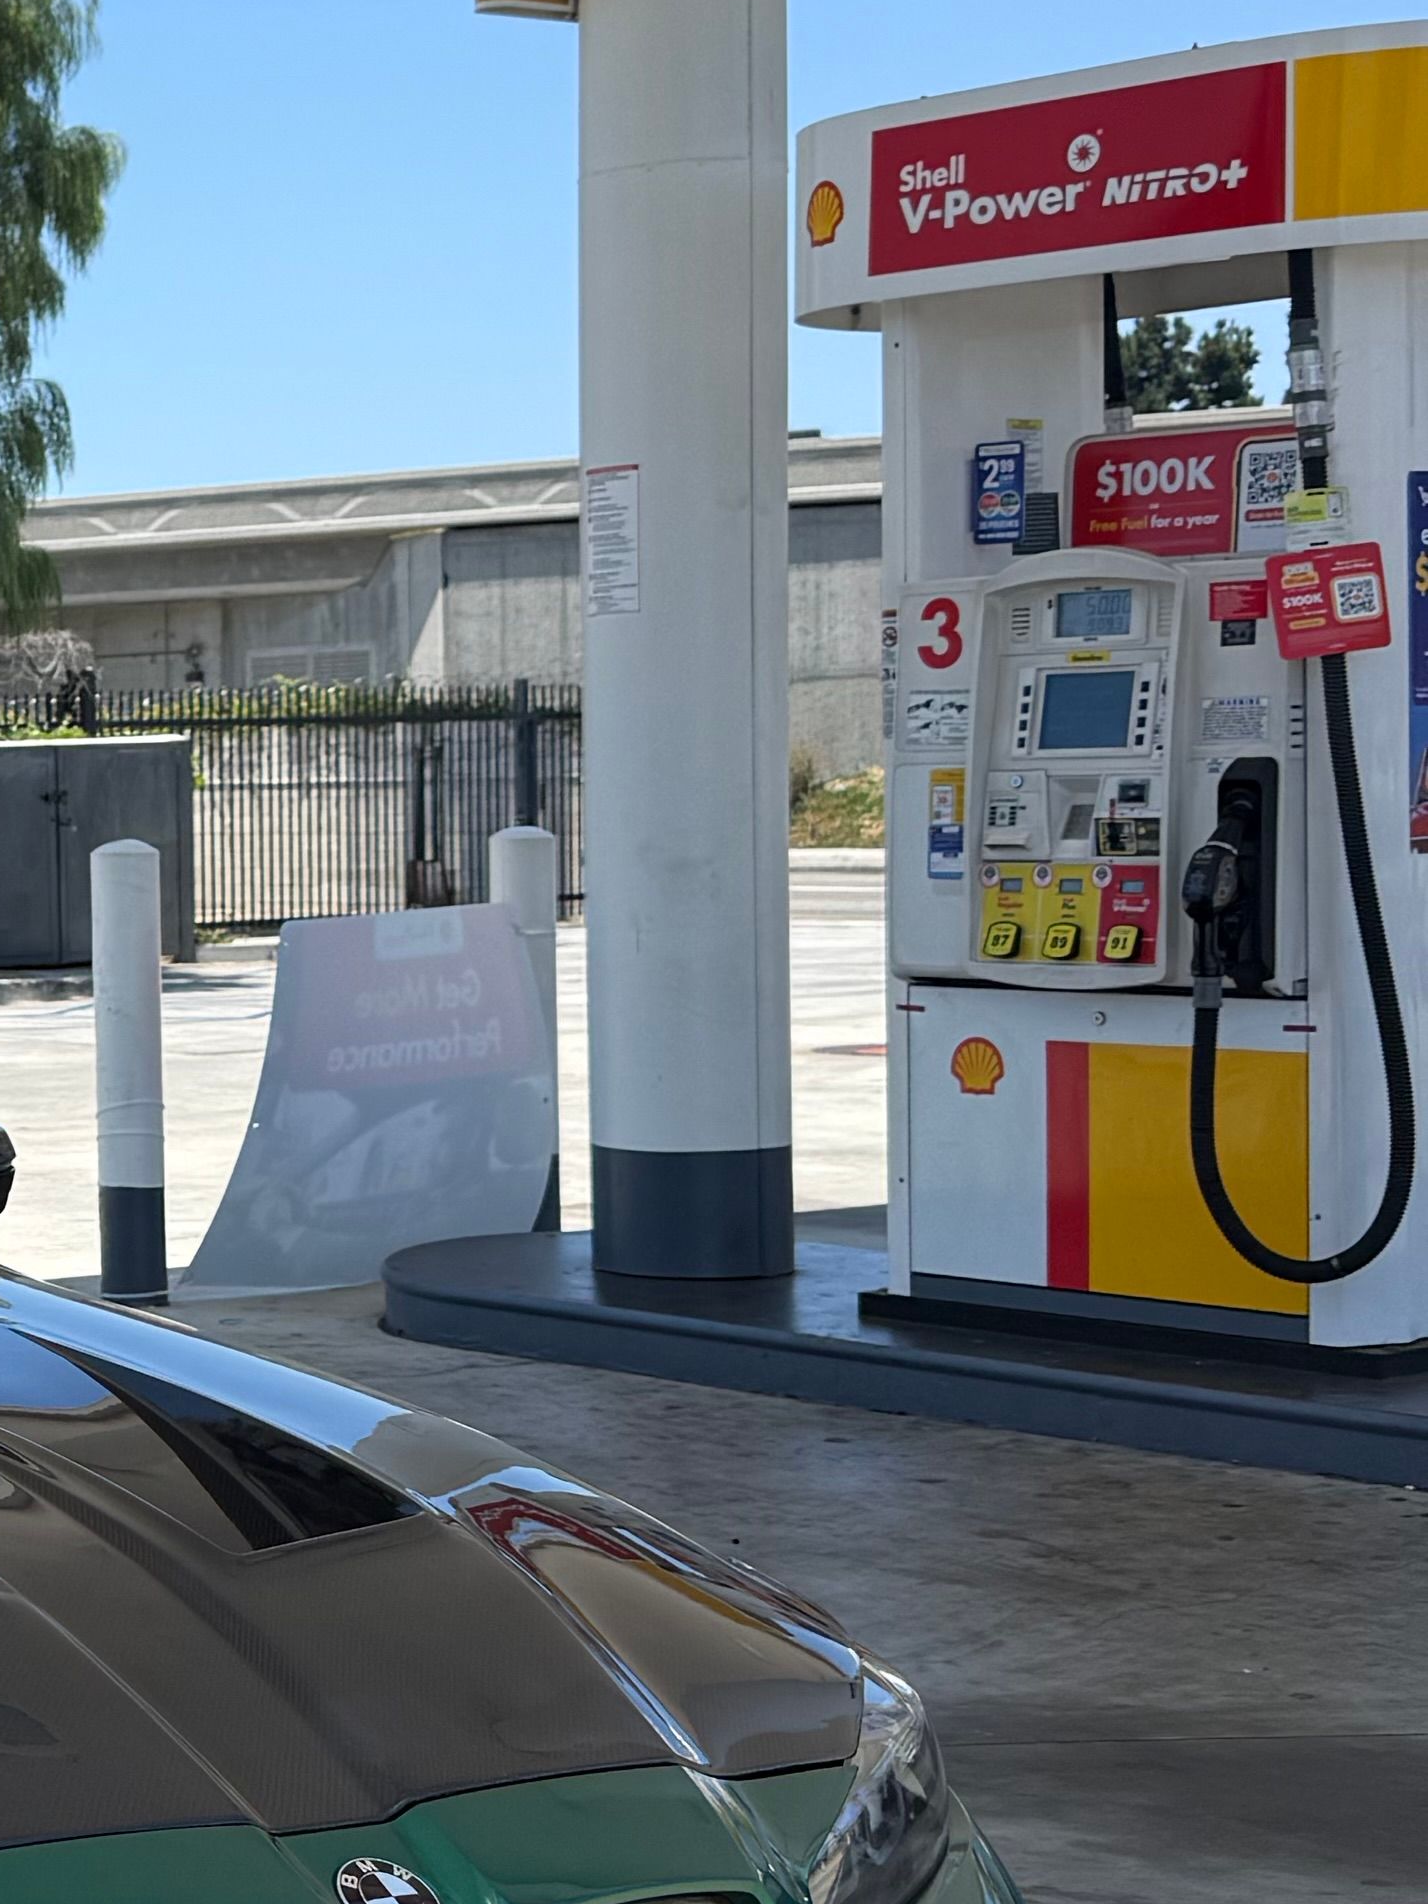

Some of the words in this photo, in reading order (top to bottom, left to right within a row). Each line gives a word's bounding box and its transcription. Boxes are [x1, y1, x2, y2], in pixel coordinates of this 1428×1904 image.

[899, 154, 966, 192] Shell
[899, 181, 1085, 234] V-Power
[1096, 455, 1217, 503] $100K
[1089, 520, 1118, 533] Free
[1121, 517, 1148, 530] Fuel
[1150, 515, 1172, 528] for
[1174, 517, 1184, 526] a
[1186, 513, 1220, 530] year
[918, 597, 963, 669] 3
[991, 934, 1010, 947] 87
[1111, 937, 1128, 950] 91
